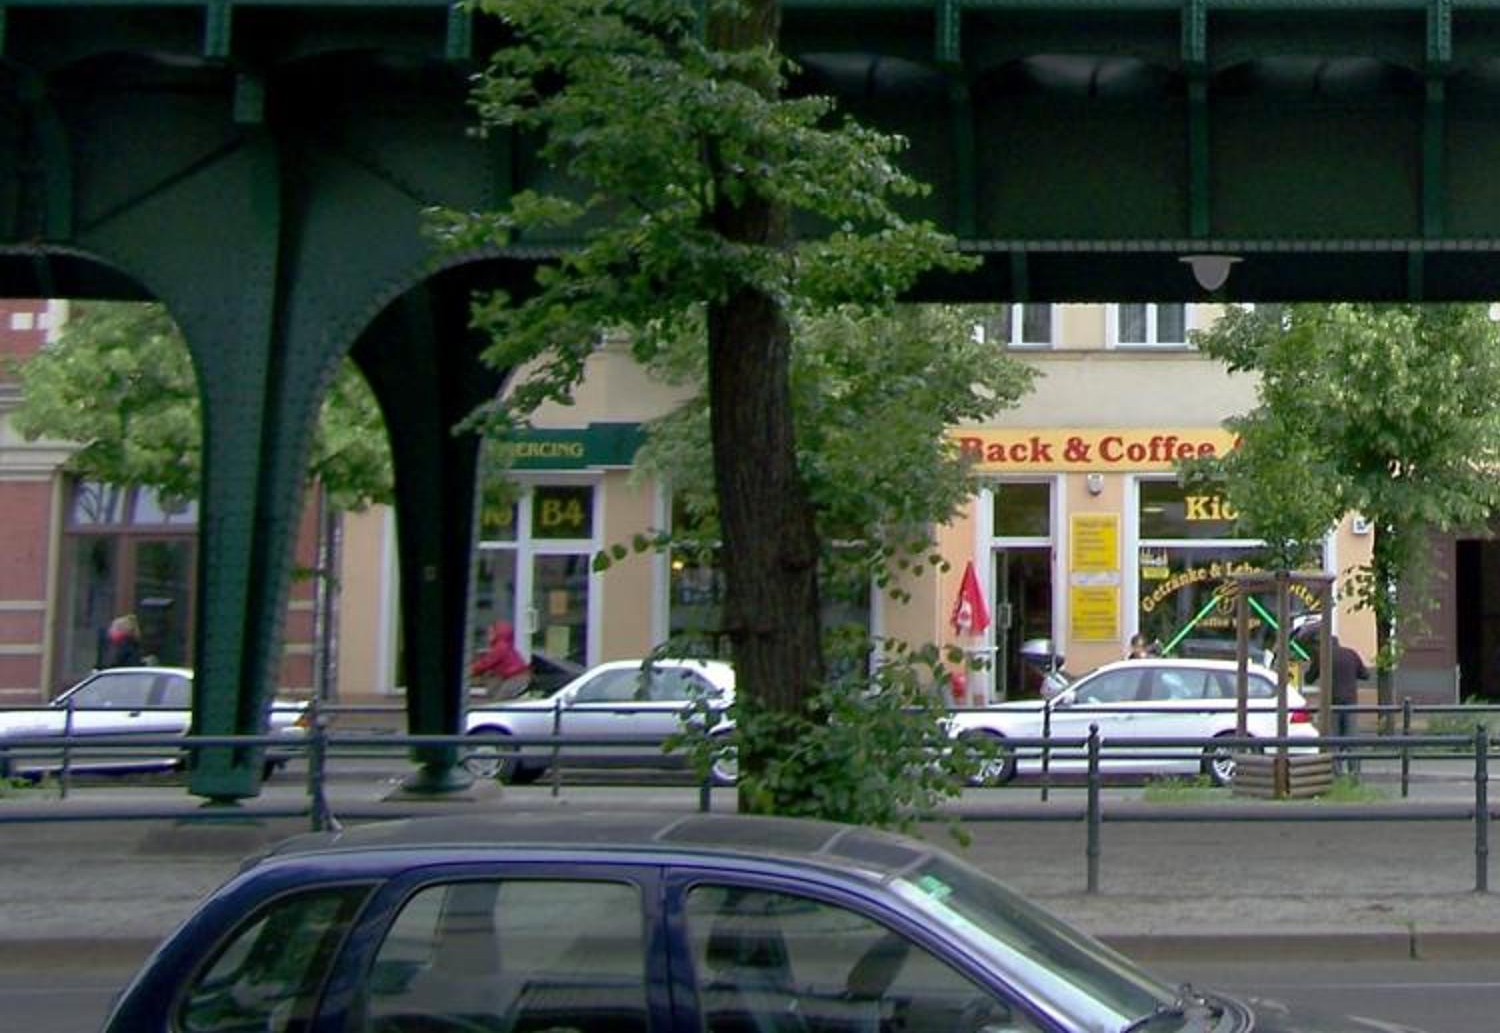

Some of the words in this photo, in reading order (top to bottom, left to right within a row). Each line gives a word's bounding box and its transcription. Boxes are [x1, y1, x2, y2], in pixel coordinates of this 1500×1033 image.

[959, 437, 1054, 464] Back
[1064, 437, 1092, 463] &
[1100, 436, 1216, 463] Coffee
